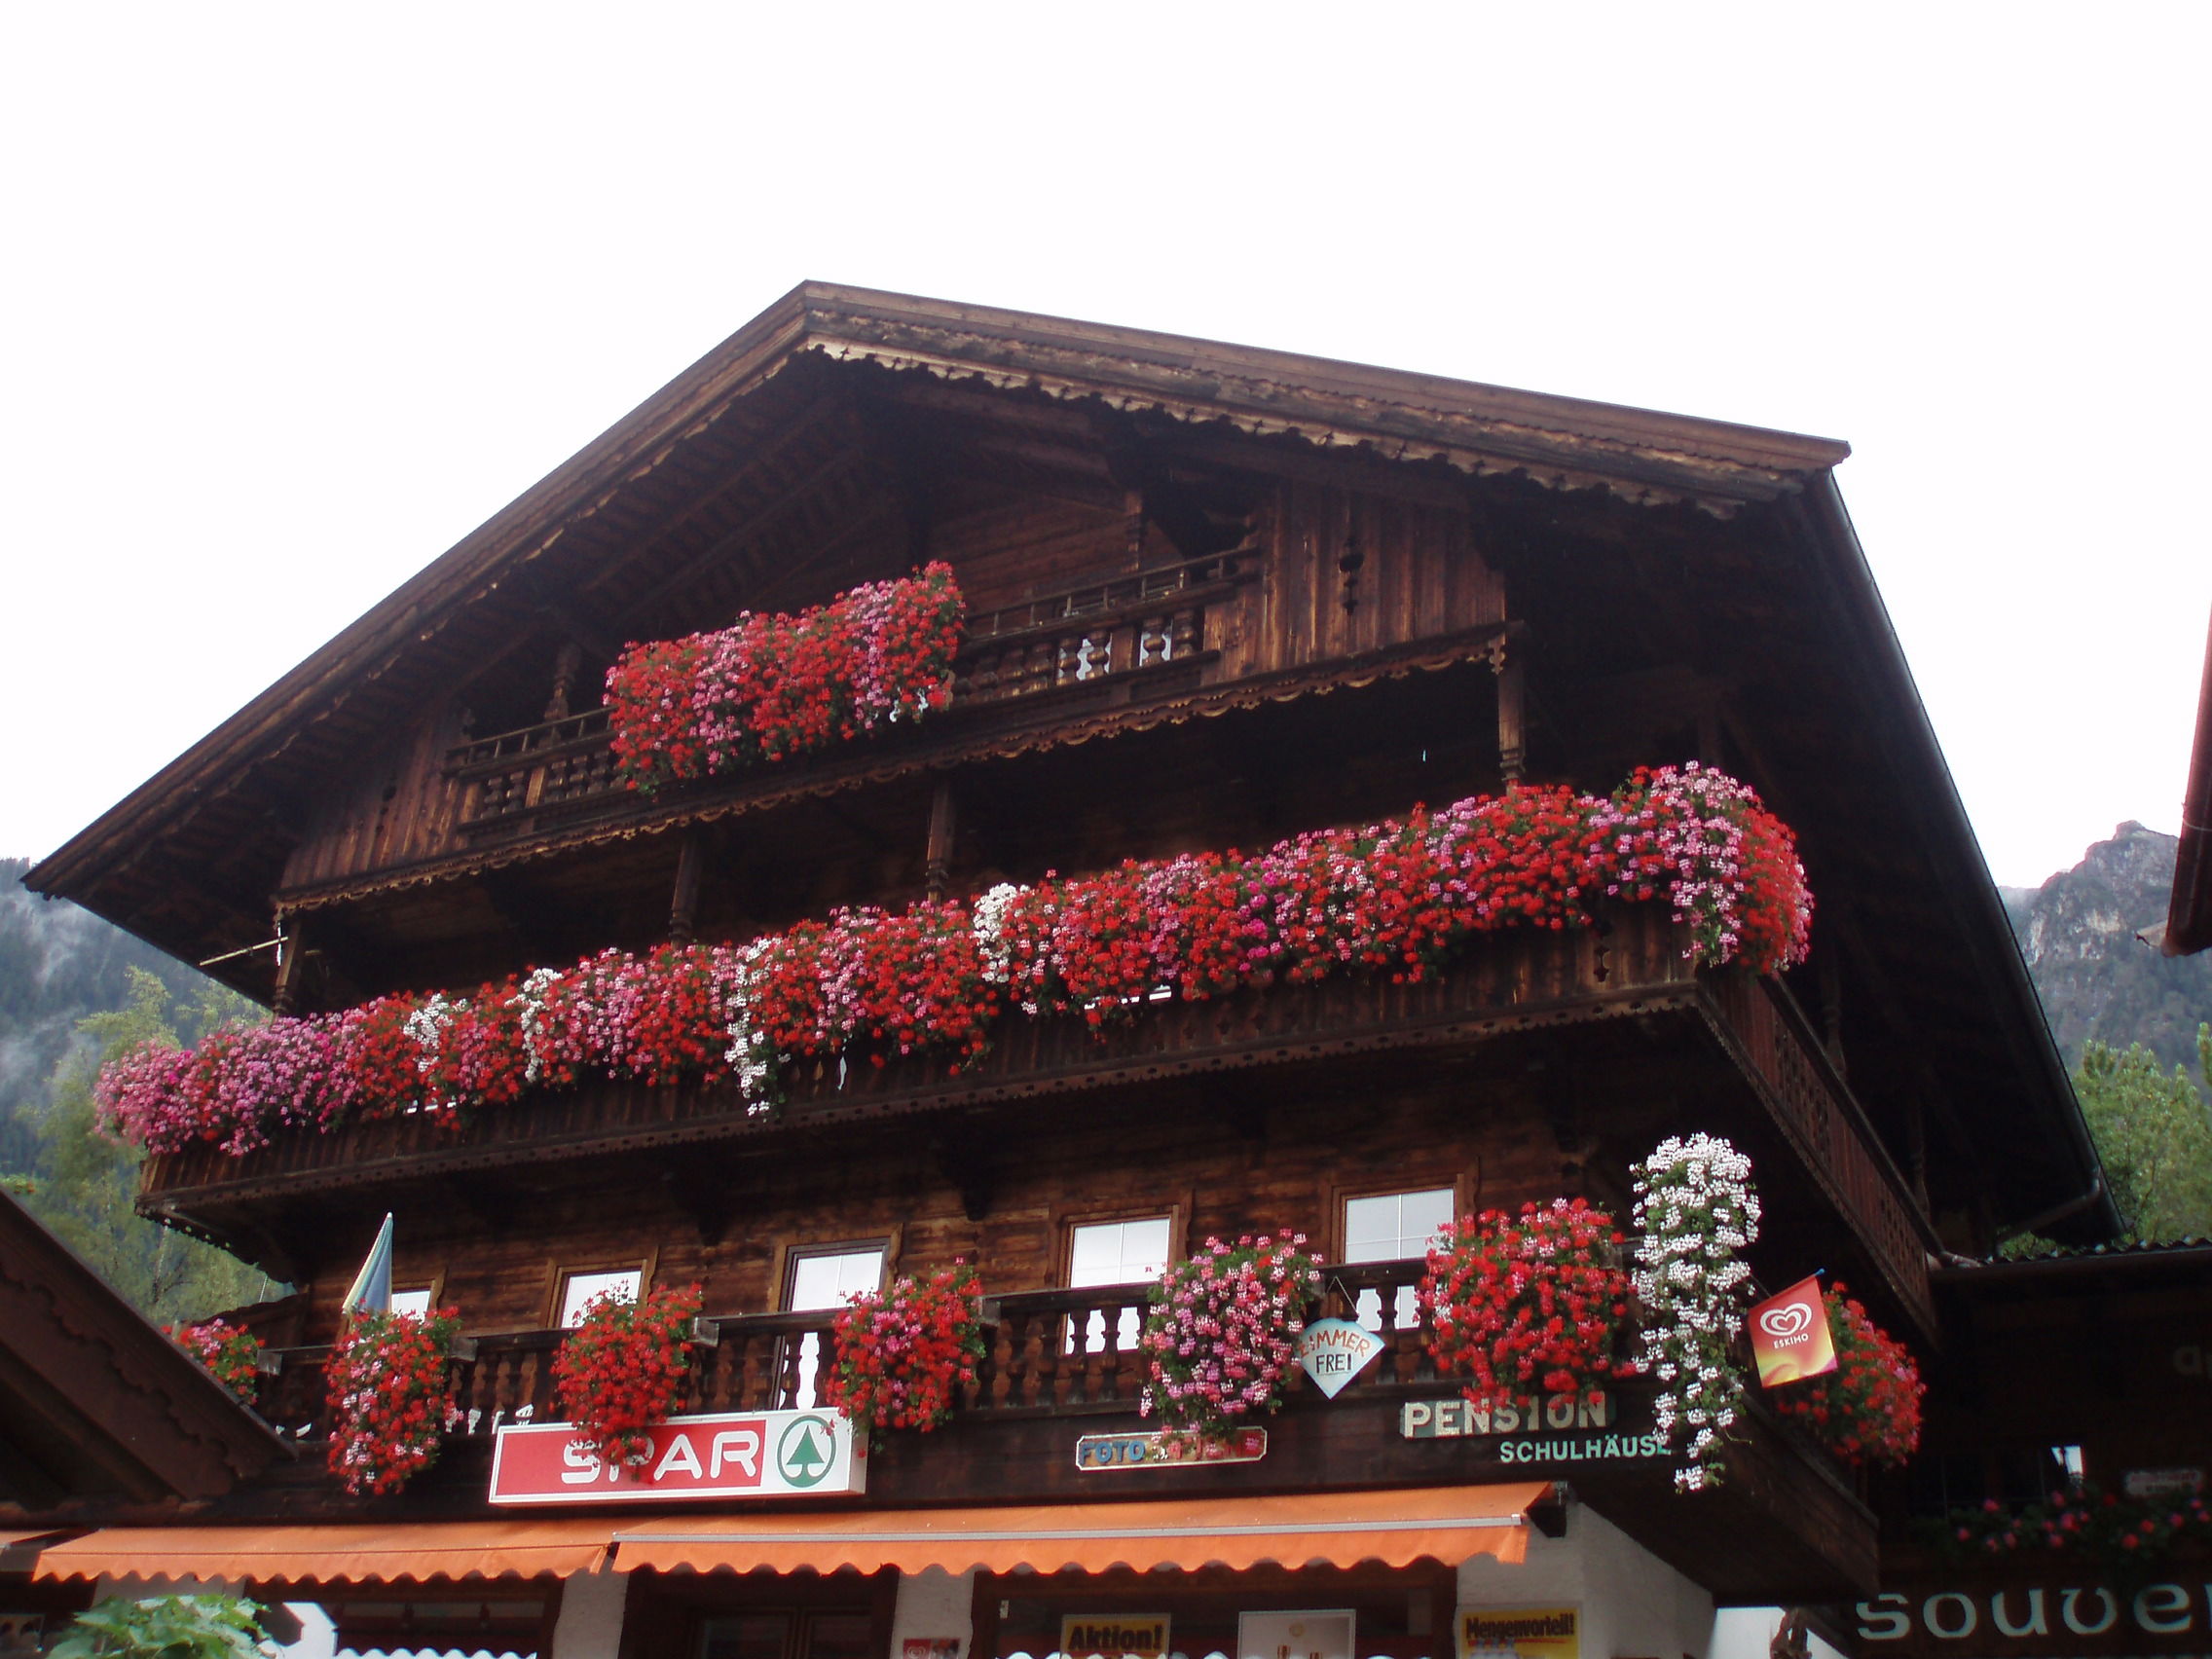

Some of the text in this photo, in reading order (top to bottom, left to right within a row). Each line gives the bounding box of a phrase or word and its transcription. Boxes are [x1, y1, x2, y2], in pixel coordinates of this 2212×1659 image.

[1774, 1333, 1809, 1349] ESKIMO
[1315, 1353, 1352, 1374] FREI
[1404, 1390, 1606, 1439] PENSION
[1080, 1440, 1146, 1465] FOTO
[1856, 1581, 2212, 1641] souve
[1067, 1624, 1162, 1650] Aktion!
[1465, 1612, 1575, 1641] Mengenvorteil!
